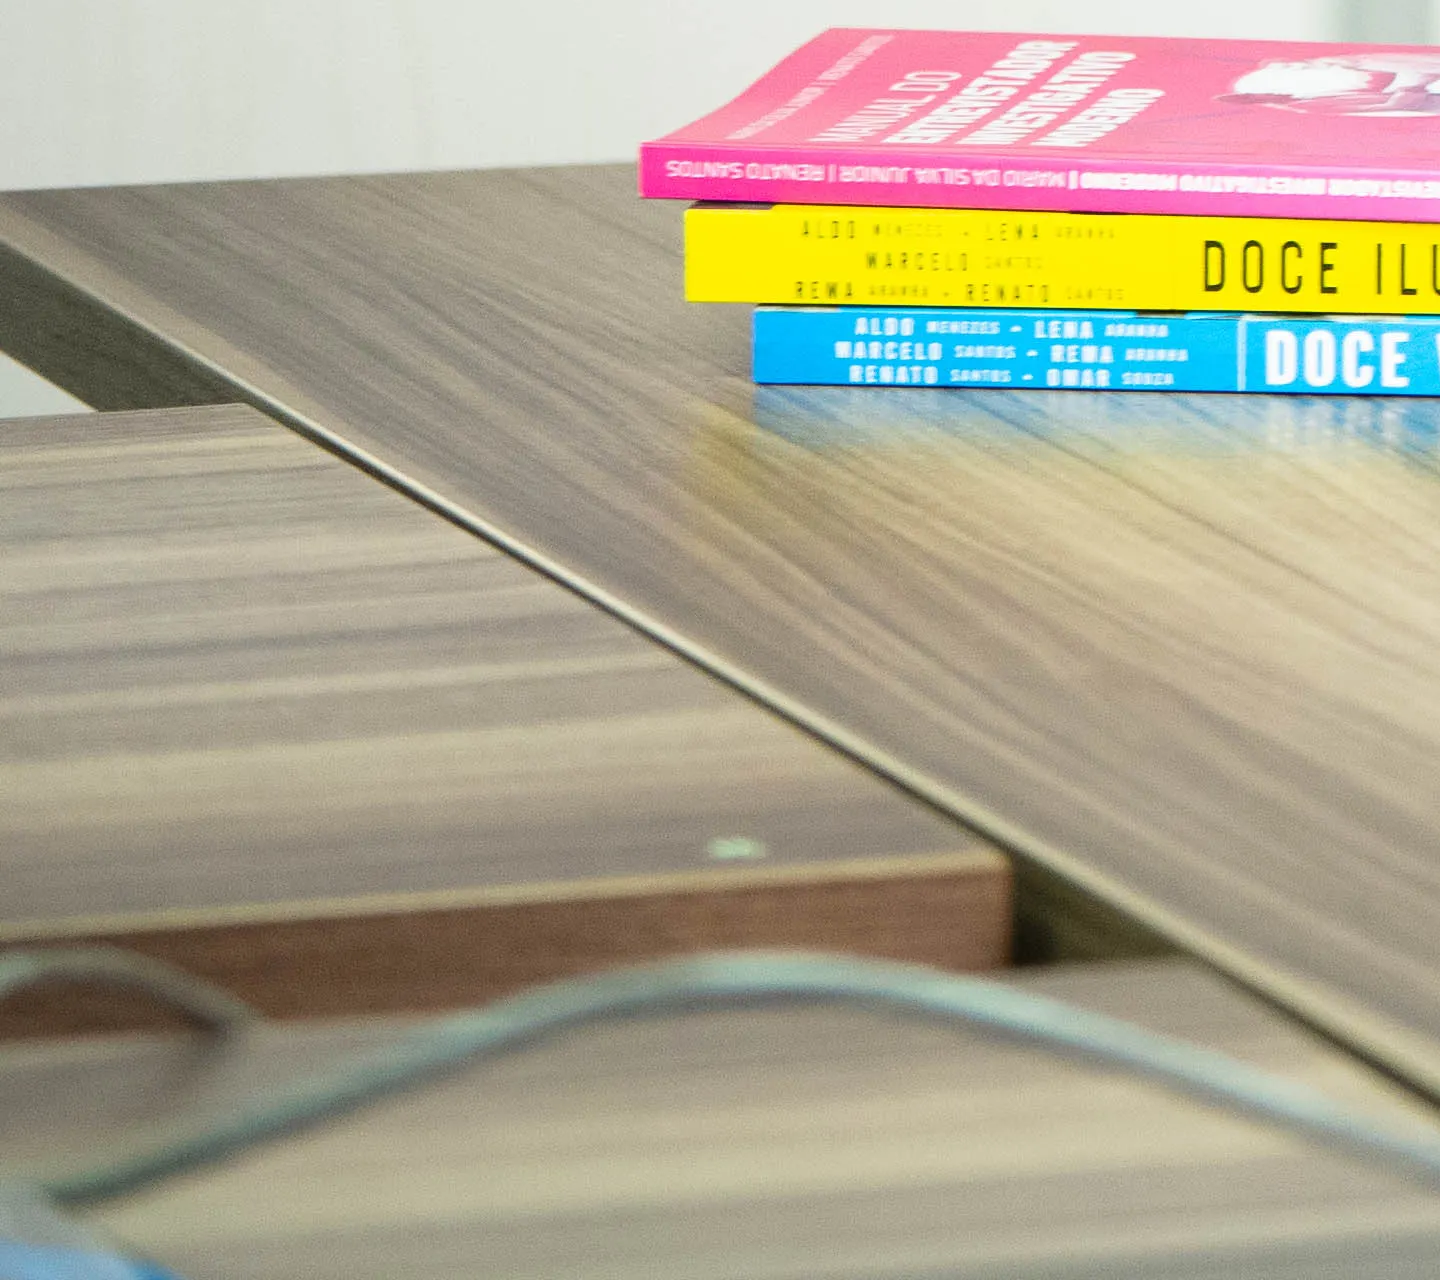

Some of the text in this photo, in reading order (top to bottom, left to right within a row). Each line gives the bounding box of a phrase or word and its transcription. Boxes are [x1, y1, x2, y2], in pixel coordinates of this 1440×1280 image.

[890, 70, 962, 92] DO
[665, 159, 745, 180] SANTOS
[801, 219, 856, 240] ALDO
[865, 251, 968, 272] MARCELO
[1204, 239, 1339, 295] DOCE
[966, 283, 1050, 303] RENATO
[854, 316, 915, 337] ALDO
[834, 340, 943, 361] MARCELO
[1265, 330, 1411, 391] DOCE
[849, 365, 939, 385] RENATO
[1046, 368, 1111, 388] OMAR
